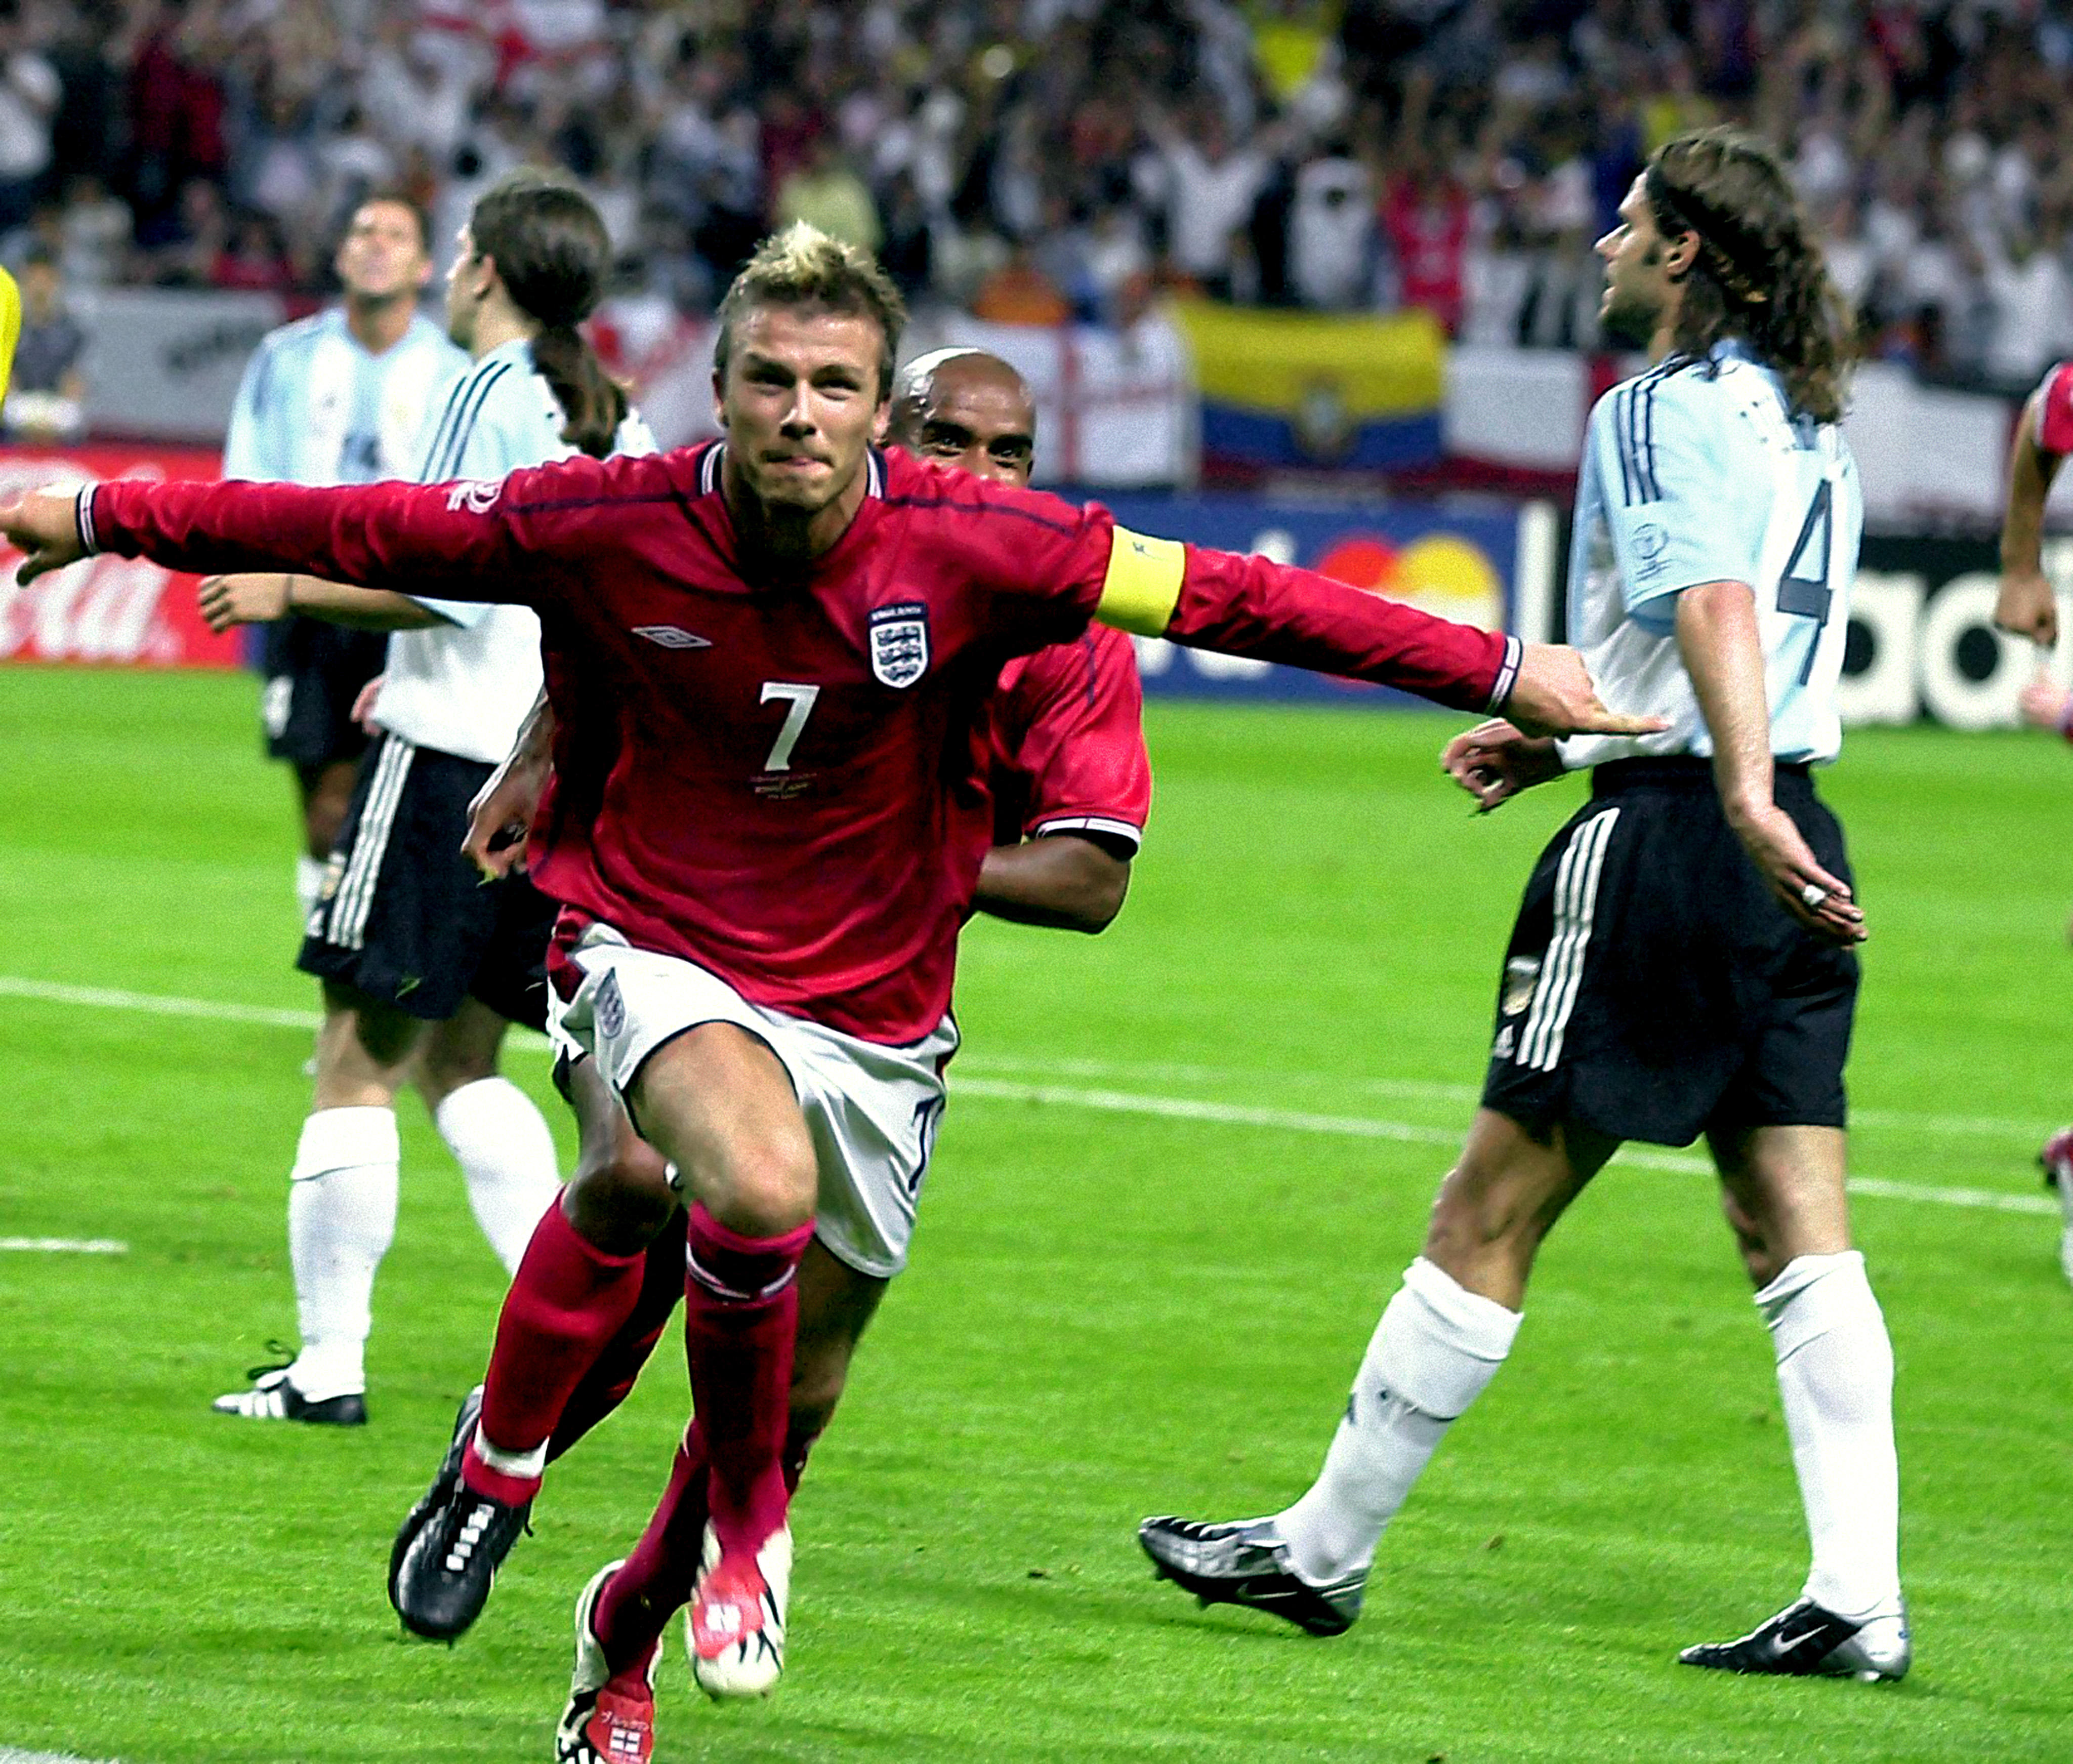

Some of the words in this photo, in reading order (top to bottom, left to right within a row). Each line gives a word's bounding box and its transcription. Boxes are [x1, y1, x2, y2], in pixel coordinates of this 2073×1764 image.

[1776, 478, 1833, 686] 4
[760, 682, 820, 771] 7
[909, 1092, 946, 1192] 7
